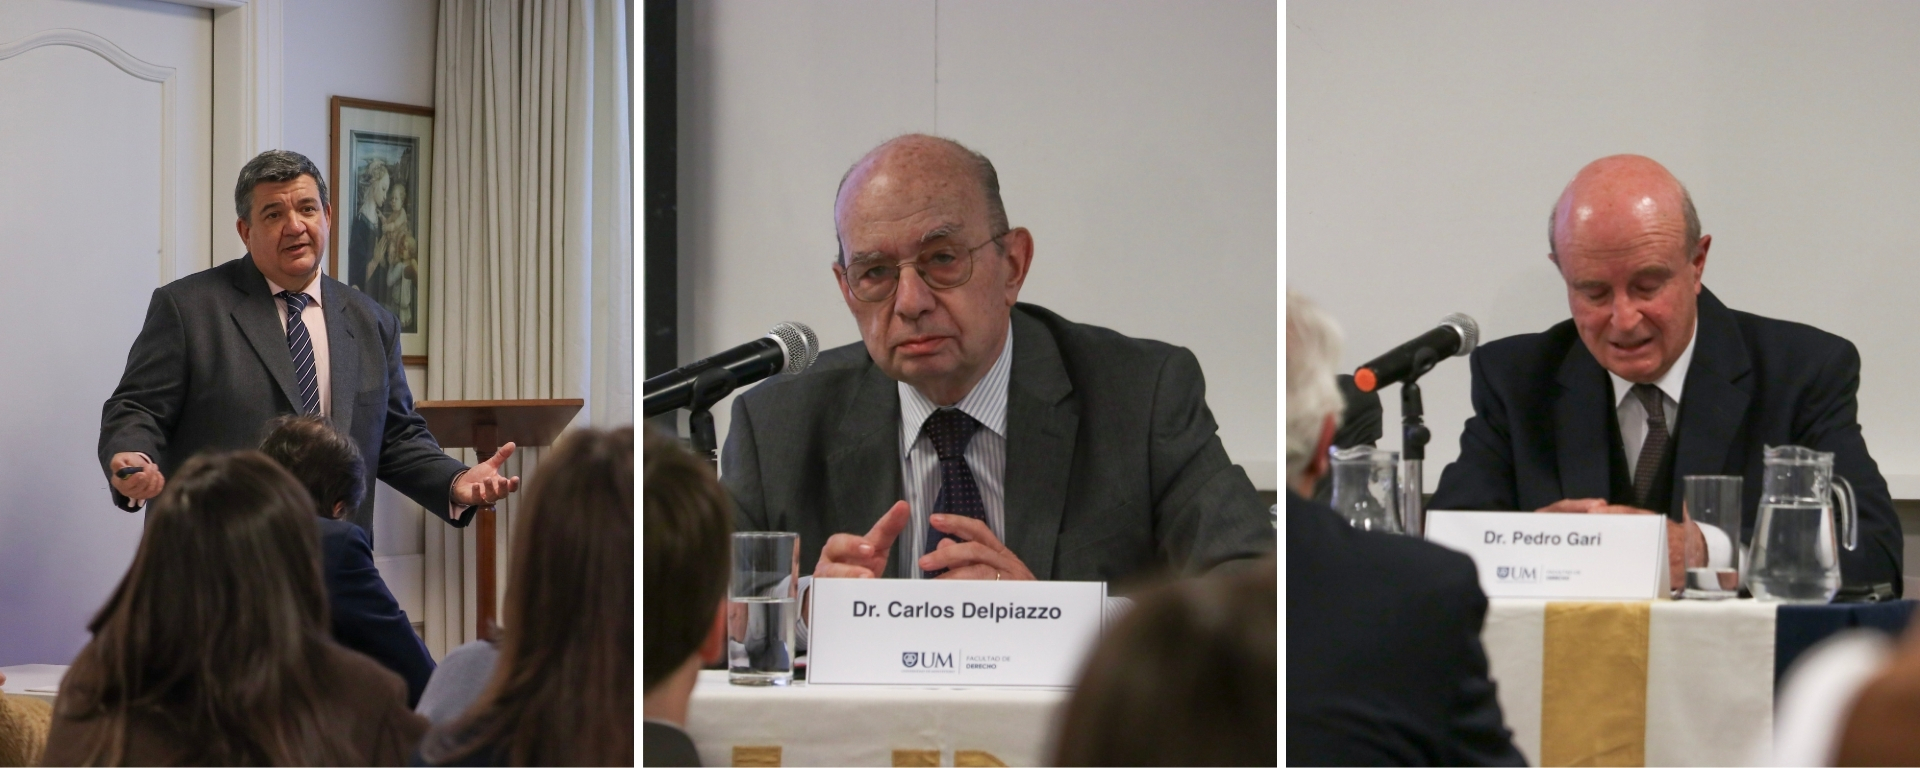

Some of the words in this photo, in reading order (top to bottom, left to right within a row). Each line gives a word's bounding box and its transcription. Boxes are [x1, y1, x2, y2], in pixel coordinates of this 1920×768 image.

[1484, 530, 1506, 545] Dr.
[1512, 531, 1562, 546] Pedro
[1511, 567, 1537, 580] UM
[852, 601, 880, 618] Dr.
[888, 601, 955, 619] Carlos
[961, 602, 1062, 623] Delpiazzo
[921, 652, 954, 669] UM
[966, 663, 997, 671] DERECHO
